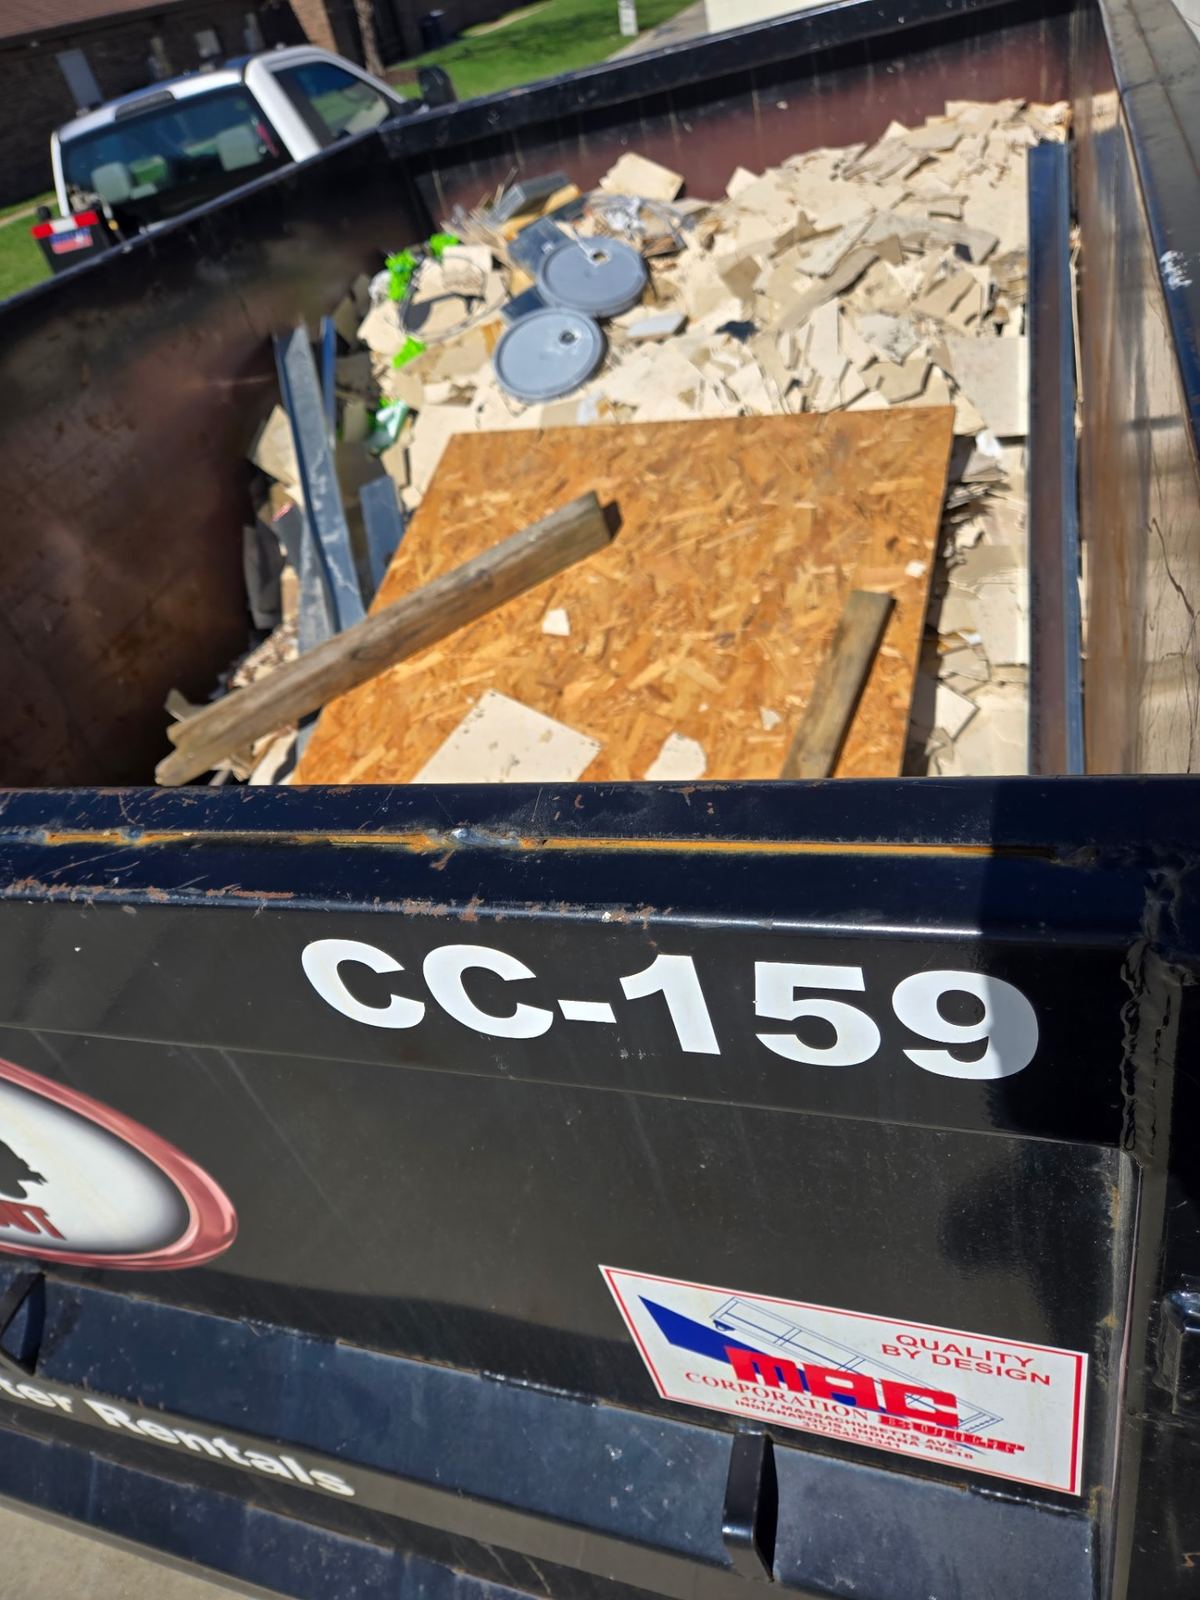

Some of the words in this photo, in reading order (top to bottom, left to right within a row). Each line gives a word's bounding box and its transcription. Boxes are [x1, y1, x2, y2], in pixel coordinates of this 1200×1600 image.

[301, 938, 1039, 1079] CC-159
[882, 1344, 920, 1360] BY
[932, 1354, 1051, 1386] DESIGN
[896, 1335, 1034, 1368] QUALITY
[683, 1370, 869, 1421] CORPORATION
[878, 1414, 1025, 1455] BUILT
[724, 1346, 958, 1427] MAC
[83, 1398, 355, 1496] Rentals
[779, 1404, 919, 1440] MASSACHUSETTS
[851, 1426, 919, 1447] INDIANA
